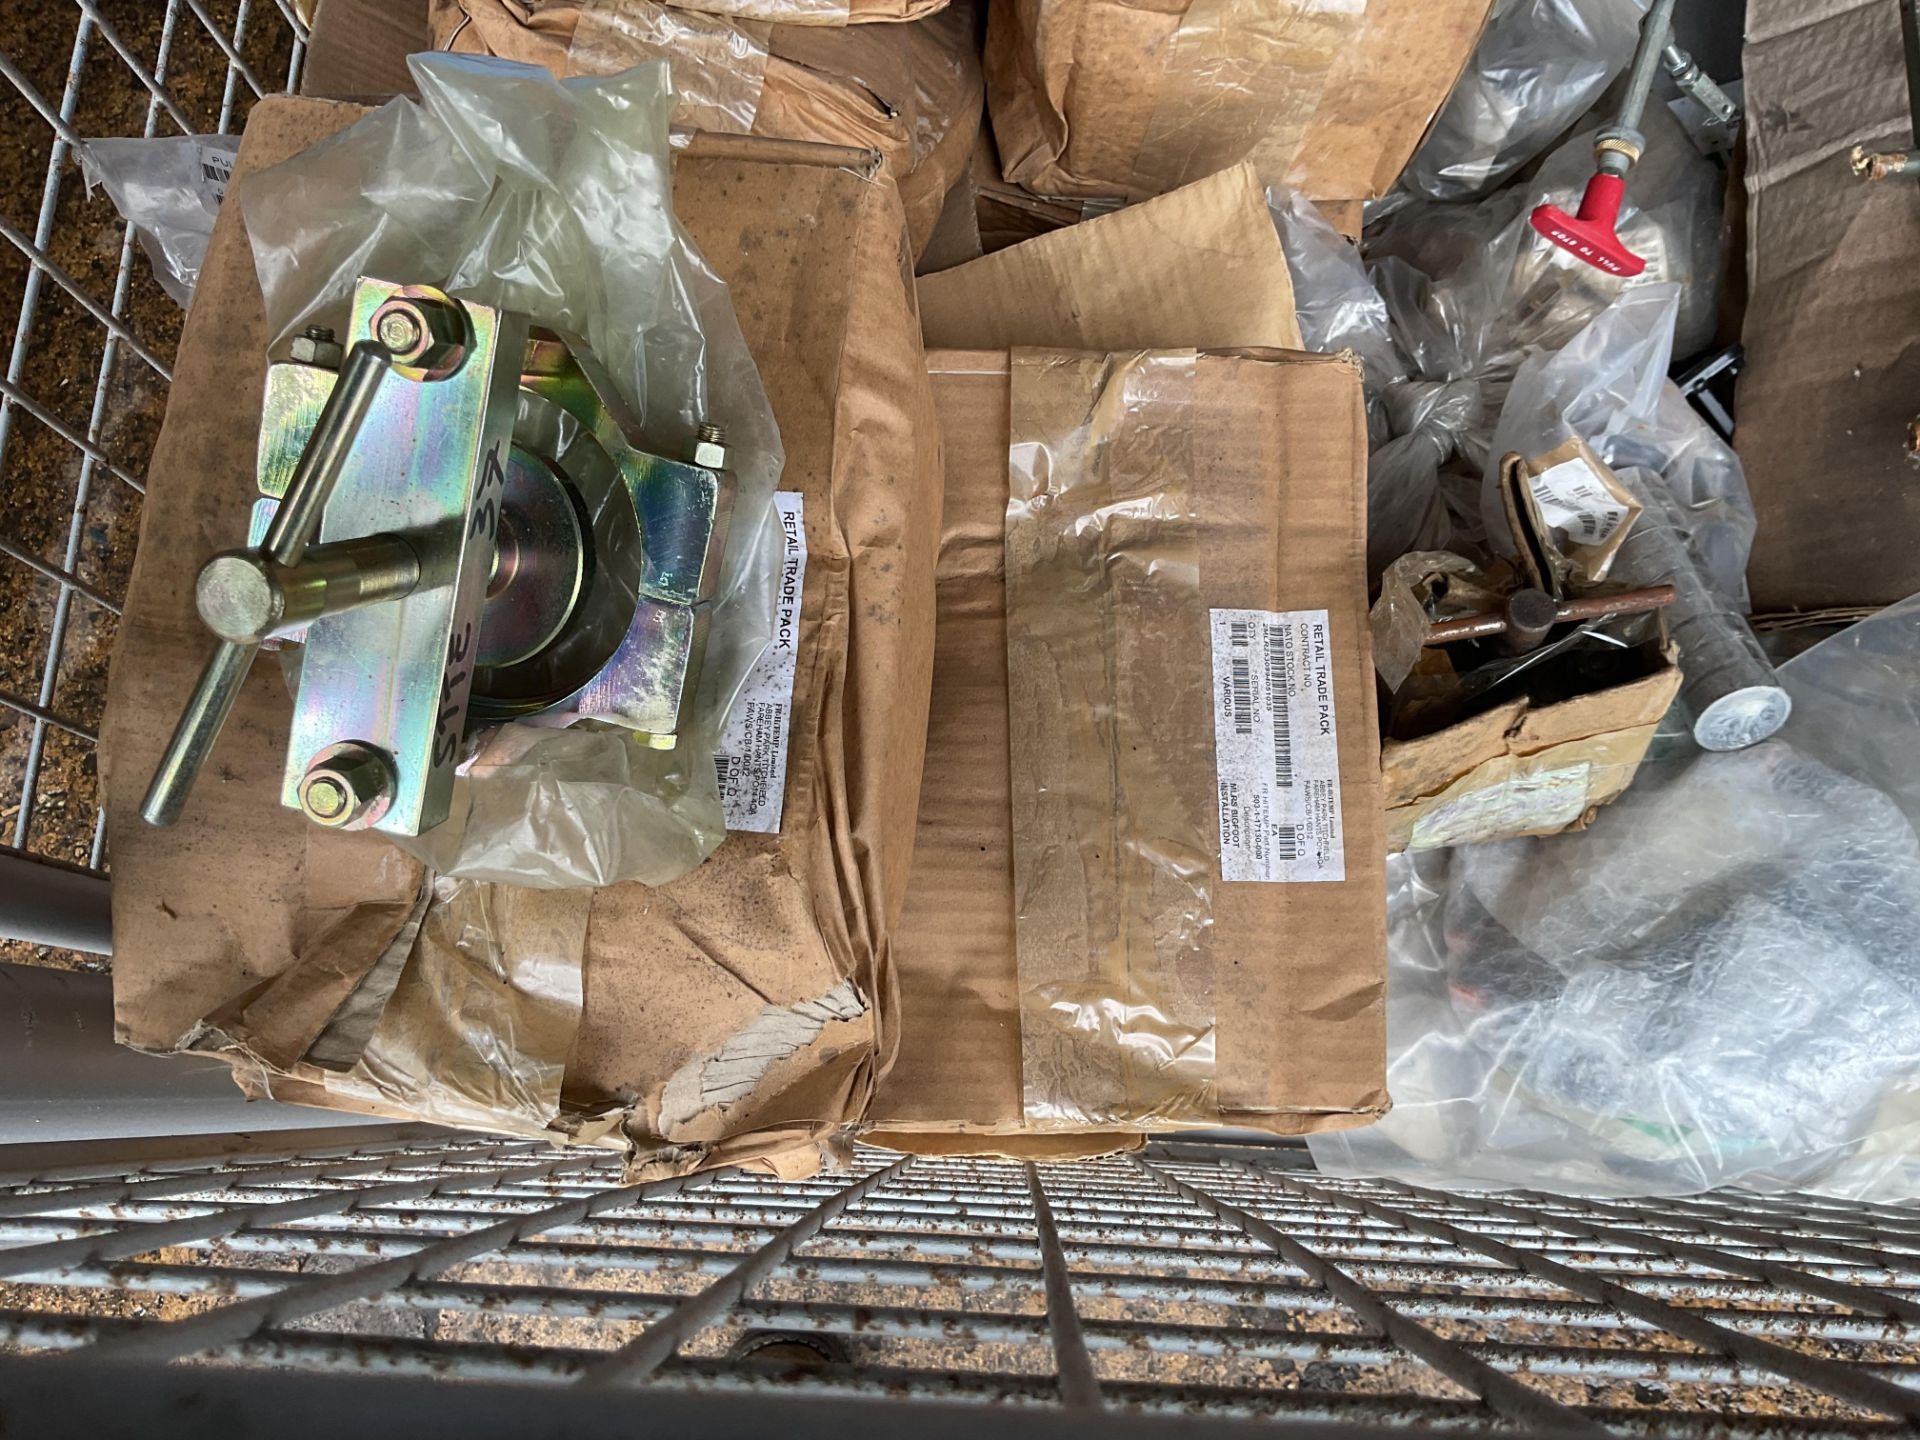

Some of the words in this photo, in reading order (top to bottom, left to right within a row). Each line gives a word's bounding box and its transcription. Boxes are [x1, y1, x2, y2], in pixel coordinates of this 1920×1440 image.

[1579, 246, 1594, 256] TO
[784, 512, 798, 554] RETAIL
[782, 558, 798, 604] TRADE
[779, 609, 792, 649] PACK
[1248, 622, 1256, 640] QTY
[1284, 624, 1293, 649] NATO
[1313, 624, 1325, 662] RETAIL
[1300, 623, 1311, 672] CONTRACT
[1286, 651, 1295, 681] STOCK
[1223, 676, 1232, 718] VARIOUS
[1251, 675, 1259, 705] SERIAL
[1288, 684, 1296, 697] NO
[1315, 665, 1328, 702] TRADE
[755, 702, 764, 743] FAREHAM
[764, 703, 773, 731] ABBEY
[1253, 708, 1260, 723] NO
[1319, 704, 1330, 736] PACK
[762, 733, 770, 755] PARK
[731, 757, 740, 765] D
[770, 751, 778, 778] Limited
[729, 768, 738, 784] OF
[758, 760, 768, 806] TITCHFIELD
[1262, 783, 1268, 794] FR
[727, 788, 737, 796] Q
[1230, 783, 1238, 806] MLRS
[1221, 782, 1230, 844] INSTALLATION
[1231, 809, 1239, 848] BIGFOOT
[1271, 824, 1278, 836] EA
[1297, 833, 1305, 846] OF
